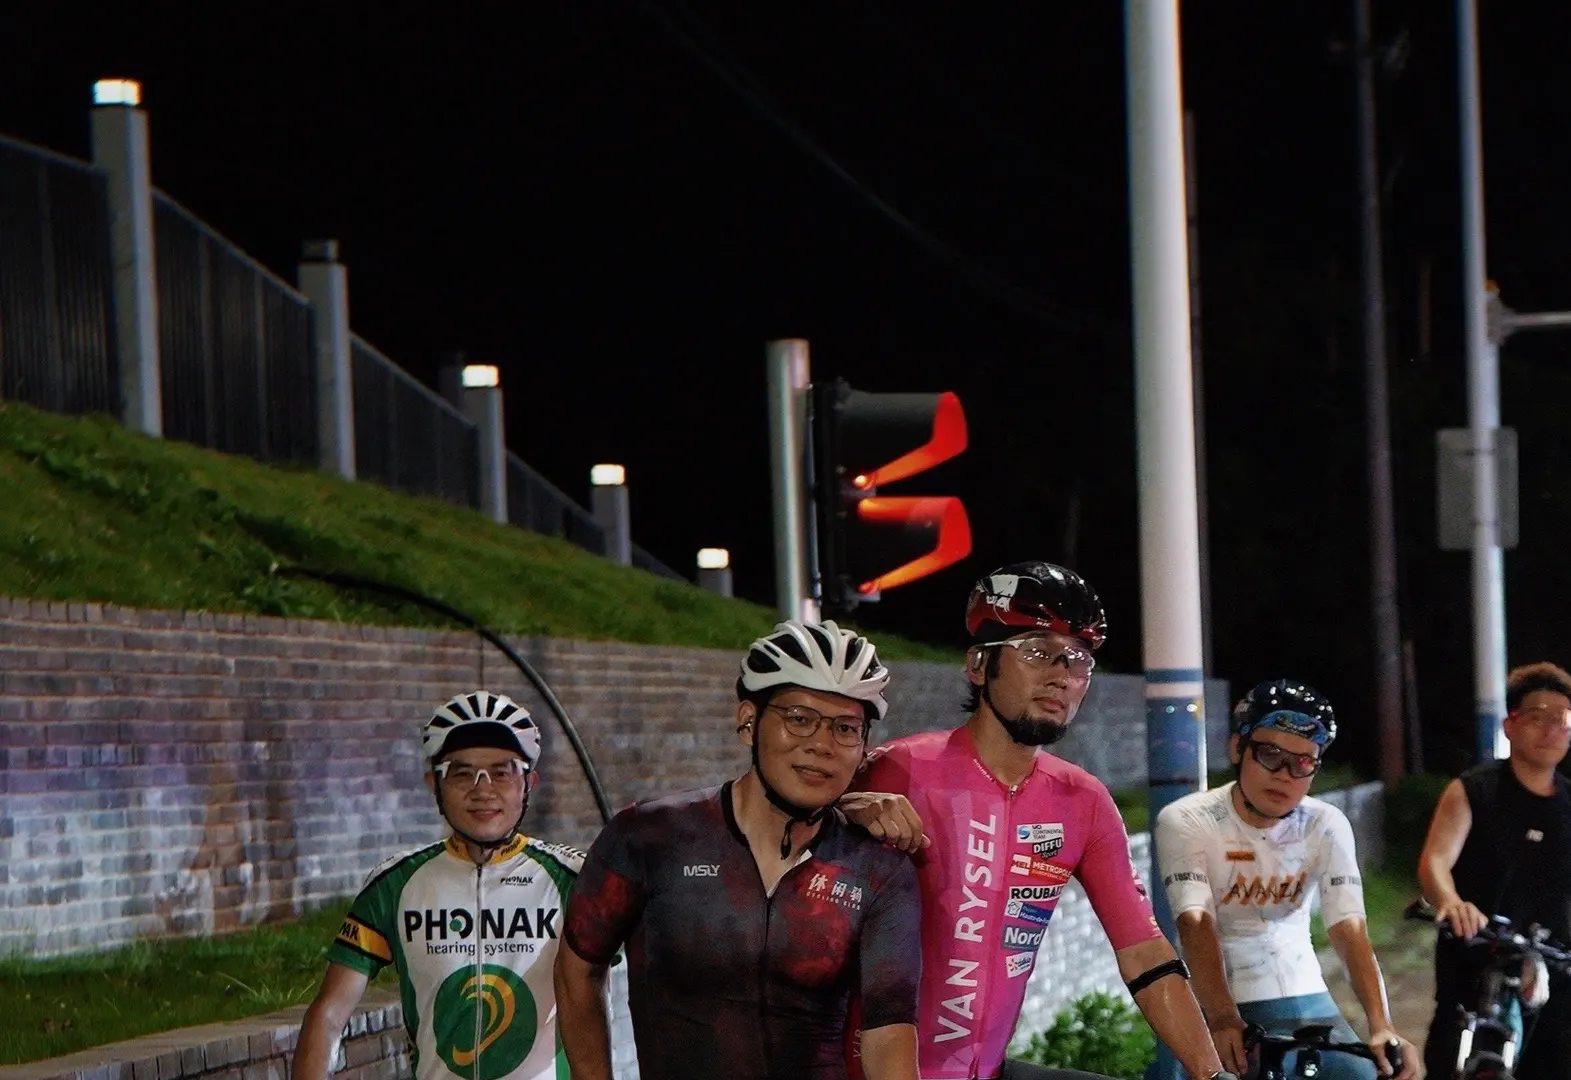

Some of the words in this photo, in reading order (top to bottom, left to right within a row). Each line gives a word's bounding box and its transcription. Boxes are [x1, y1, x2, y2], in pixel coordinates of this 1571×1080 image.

[1033, 838, 1062, 854] DIFFU
[500, 876, 534, 885] PHONAK
[954, 814, 997, 943] RYSEL
[404, 907, 559, 943] PHONAK
[1005, 926, 1044, 946] Nord
[426, 943, 476, 956] hearing
[484, 941, 535, 956] systems
[934, 958, 980, 1043] VAN
